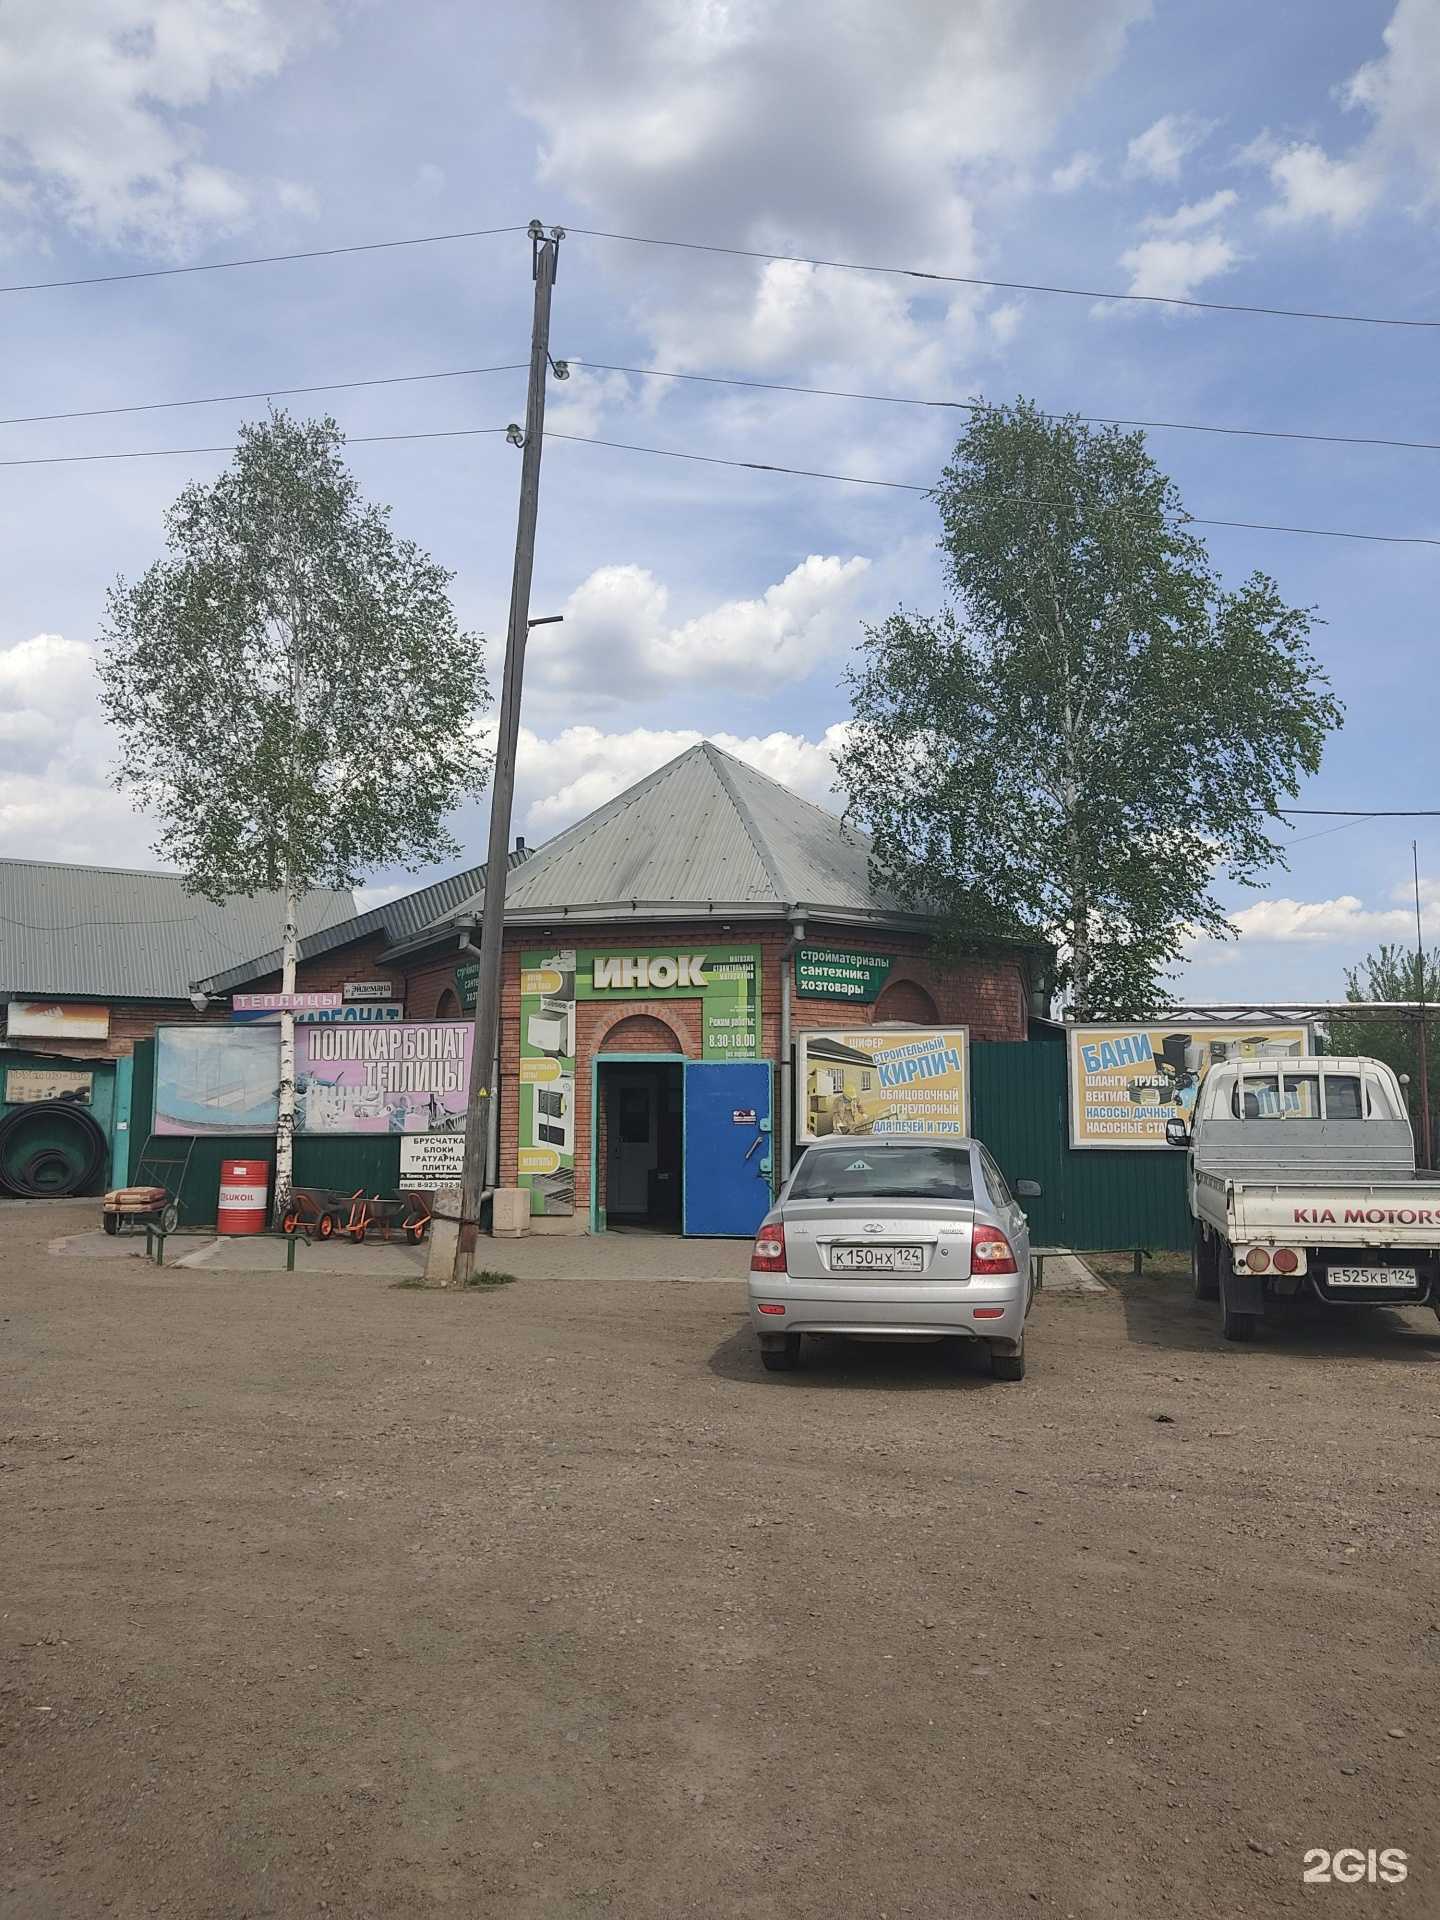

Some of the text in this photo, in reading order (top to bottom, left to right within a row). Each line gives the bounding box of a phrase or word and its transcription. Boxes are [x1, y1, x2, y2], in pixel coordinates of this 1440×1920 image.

[800, 950, 889, 967] стройматериалы
[593, 954, 709, 988] ИНОК
[800, 966, 870, 980] сантехника
[800, 979, 864, 996] хозтовары
[238, 995, 338, 1008] ТЕПЛИЦЫ
[308, 1028, 468, 1061] ПОЛИКАРБОНАТ
[709, 1034, 755, 1048] 8.30-18.00
[849, 1038, 884, 1049] ШИФЕР
[873, 1036, 945, 1064] СТРОИТЕЛЬНЫЙ
[1081, 1033, 1153, 1073] БАНИ
[878, 1048, 960, 1088] КИРПИЧ
[363, 1061, 464, 1096] ТЕПЛИЦЫ
[1134, 1075, 1169, 1087] ТРУБЫ
[880, 1088, 959, 1101] ОБЛИЦОВОЧНЫЙ
[1086, 1091, 1131, 1102] ВЕНТИЛЯ
[890, 1104, 959, 1115] ОГНЕУПОРНЫЙ
[1086, 1106, 1177, 1119] НАСОСЫ ДАЧНЫЕ
[873, 1119, 960, 1133] ДЛЯ ПЕЧЕЙ И ТРУБ
[1086, 1122, 1143, 1134] НАСОСНЫЕ
[413, 1137, 465, 1145] БРУСЧАТКА
[423, 1146, 454, 1154] БЛОКИ
[1294, 1208, 1440, 1225] KIA MOTORS
[835, 1248, 919, 1265] К150НХ 124
[1333, 1269, 1412, 1284] Е525КВ 124
